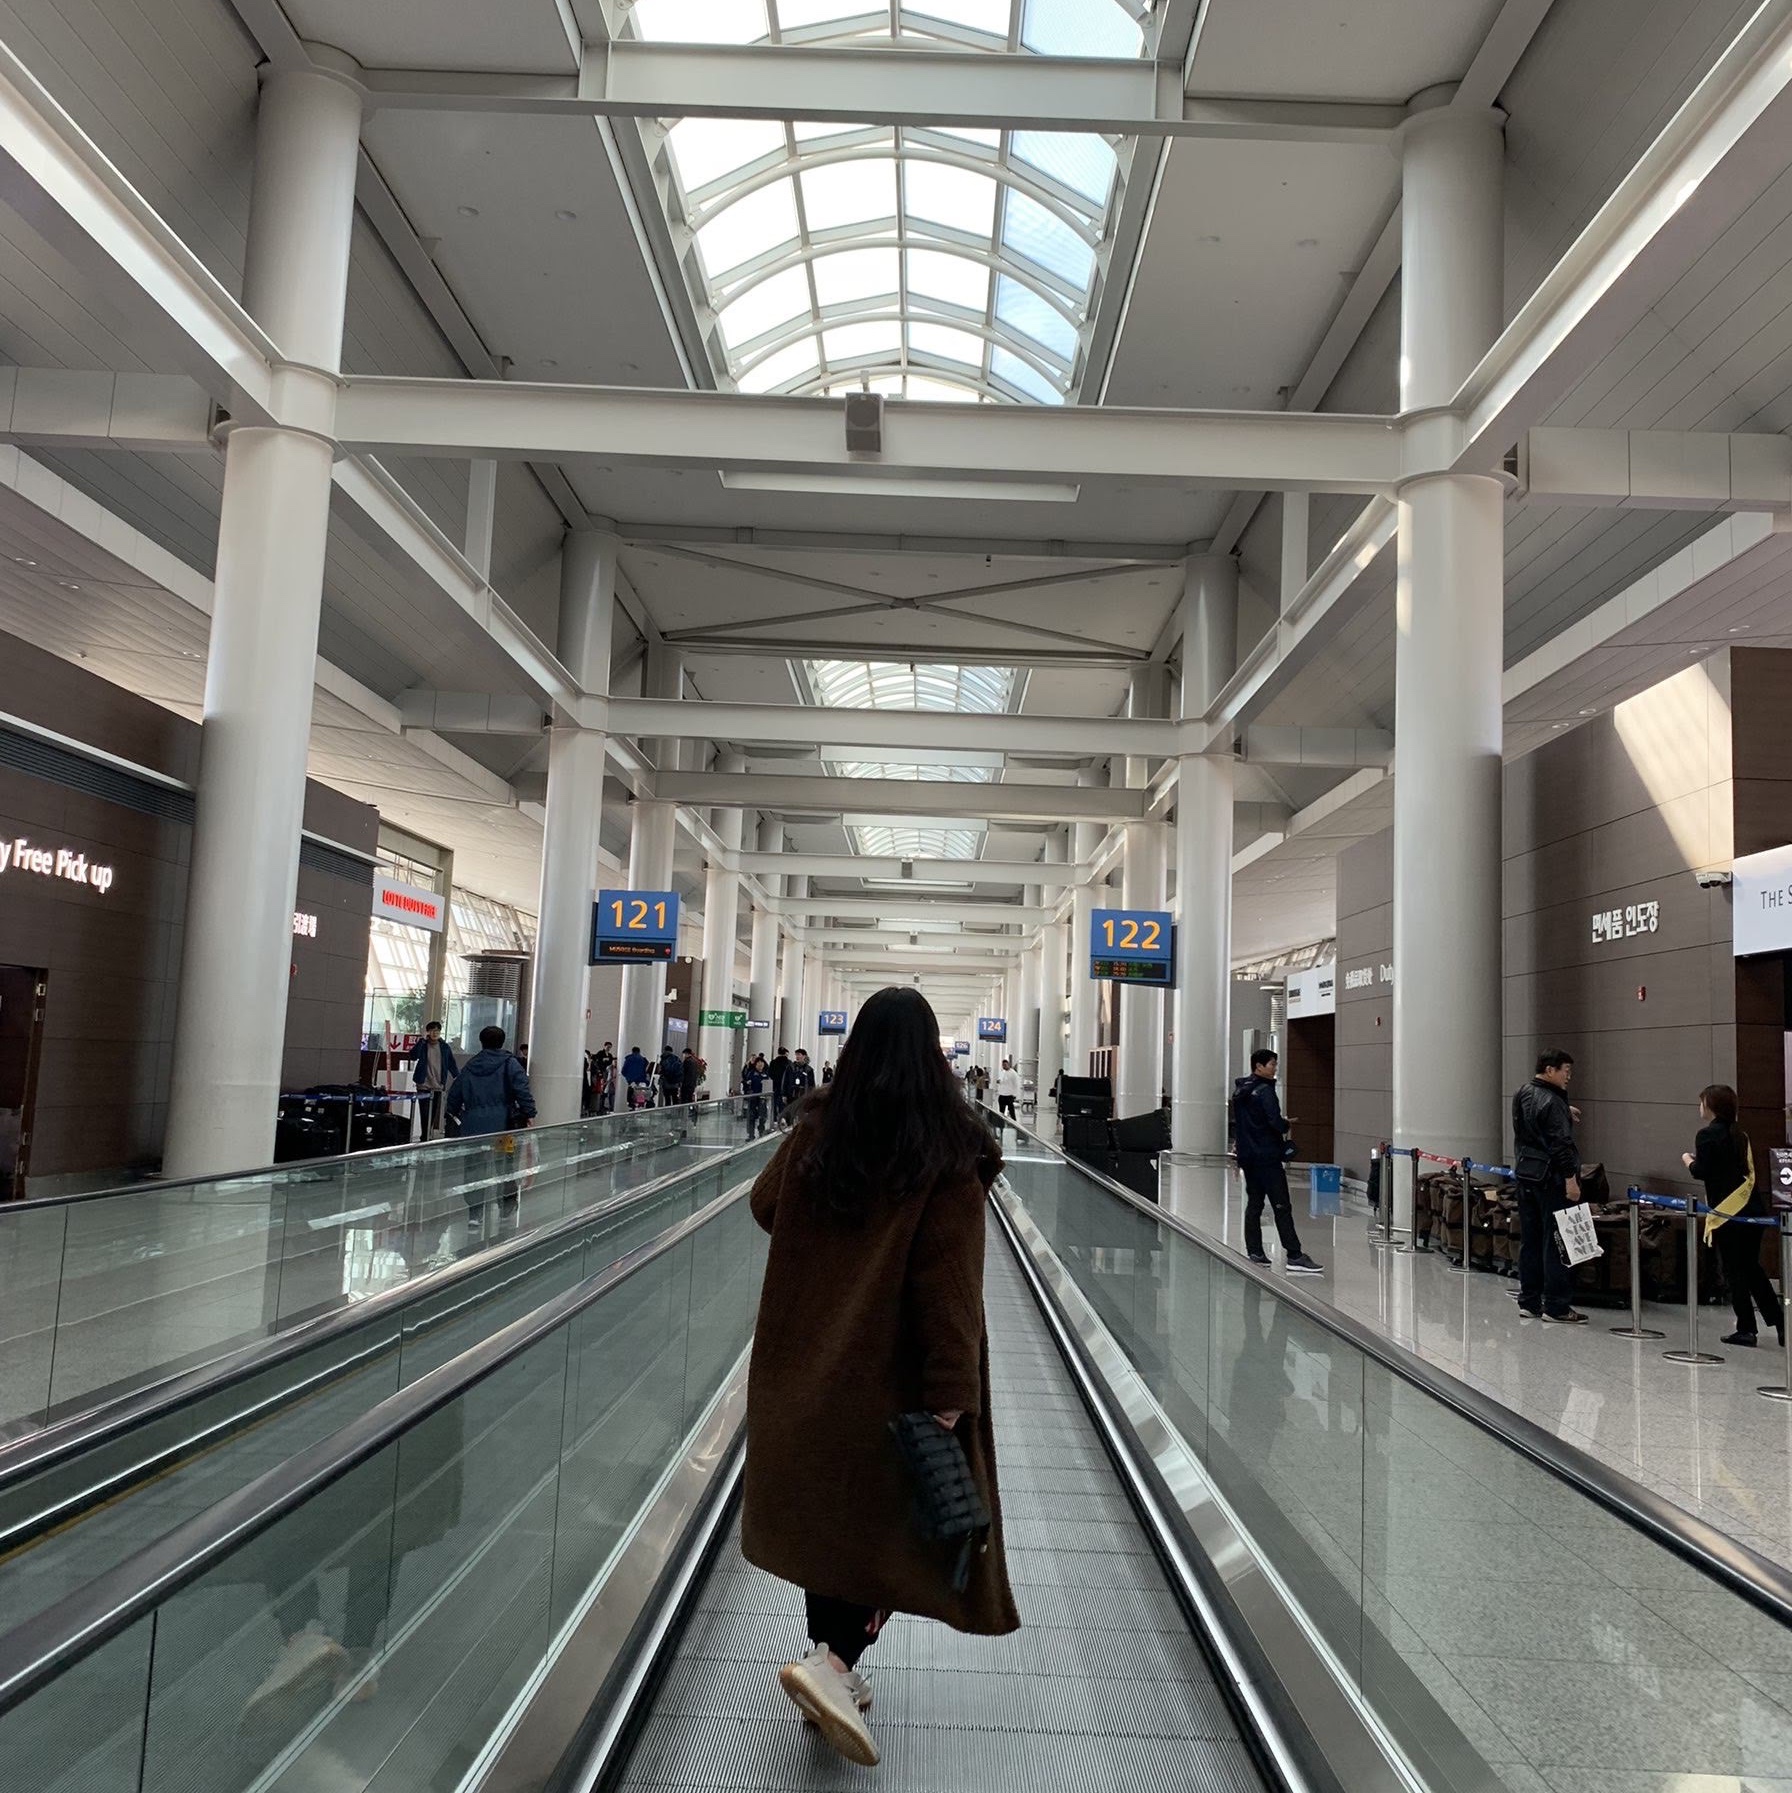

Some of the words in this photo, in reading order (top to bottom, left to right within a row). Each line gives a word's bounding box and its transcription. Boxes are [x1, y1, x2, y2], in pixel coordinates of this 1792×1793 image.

[13, 838, 53, 875] Free
[55, 849, 88, 883] Pick
[90, 864, 113, 894] up
[611, 899, 666, 929] 121
[1761, 889, 1784, 909] THE
[1102, 919, 1160, 949] 122
[1592, 908, 1623, 943] 면세품
[1625, 901, 1660, 937] 인도장
[824, 1014, 844, 1025] 123
[982, 1021, 1002, 1031] 124
